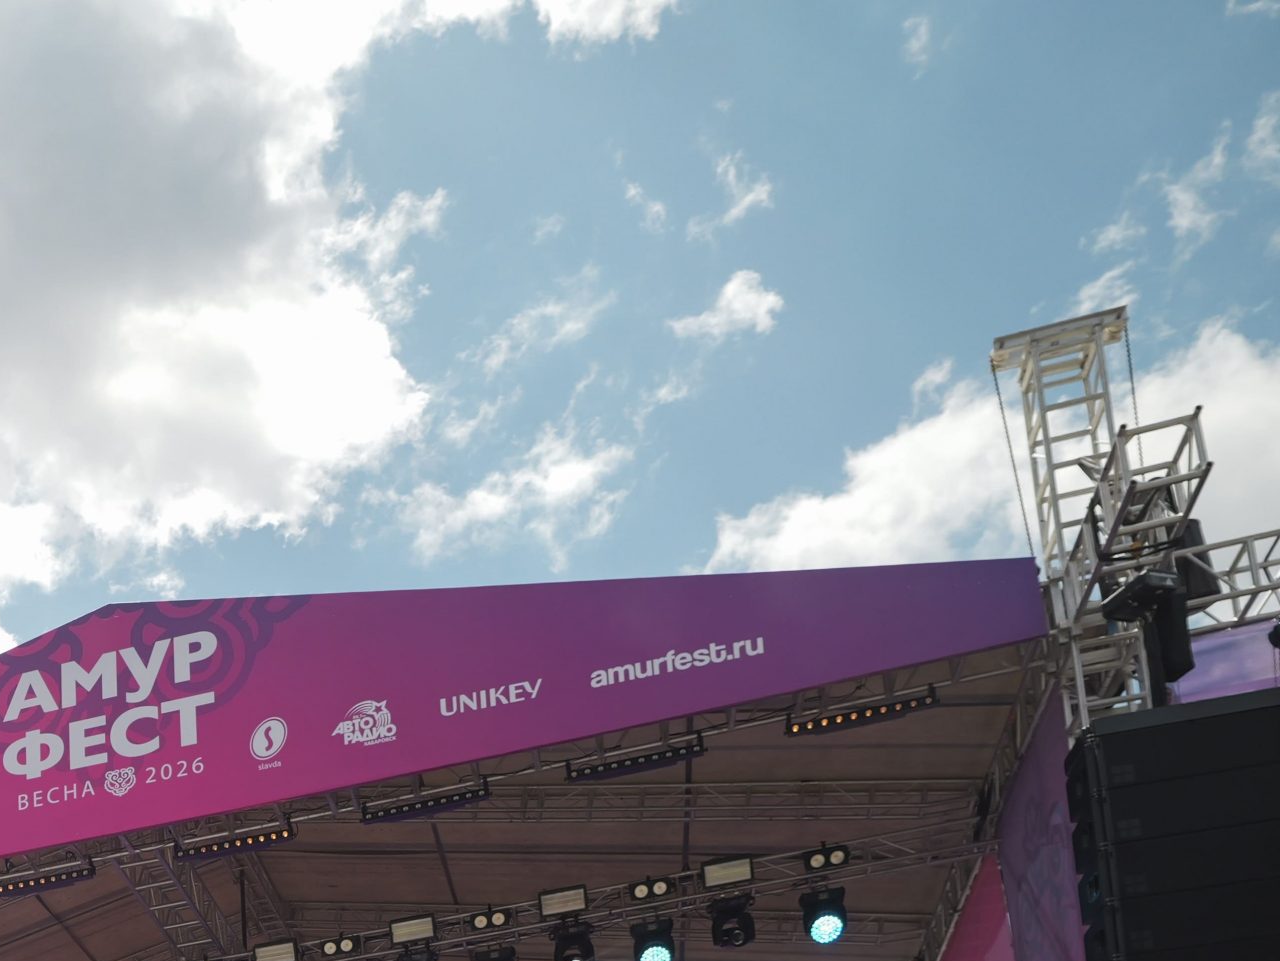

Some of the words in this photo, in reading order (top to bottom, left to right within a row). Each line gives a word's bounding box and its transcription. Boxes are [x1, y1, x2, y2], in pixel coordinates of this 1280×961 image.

[2, 630, 218, 723] АМУР
[590, 636, 765, 688] amurfest.ru
[439, 678, 543, 717] UNIKEY
[2, 691, 215, 780] ФЕСТ
[331, 716, 374, 736] АВТО
[343, 724, 397, 745] РАДИО
[18, 780, 95, 810] ВЕСНА
[145, 757, 204, 784] 2026
[258, 760, 282, 771] slavda
